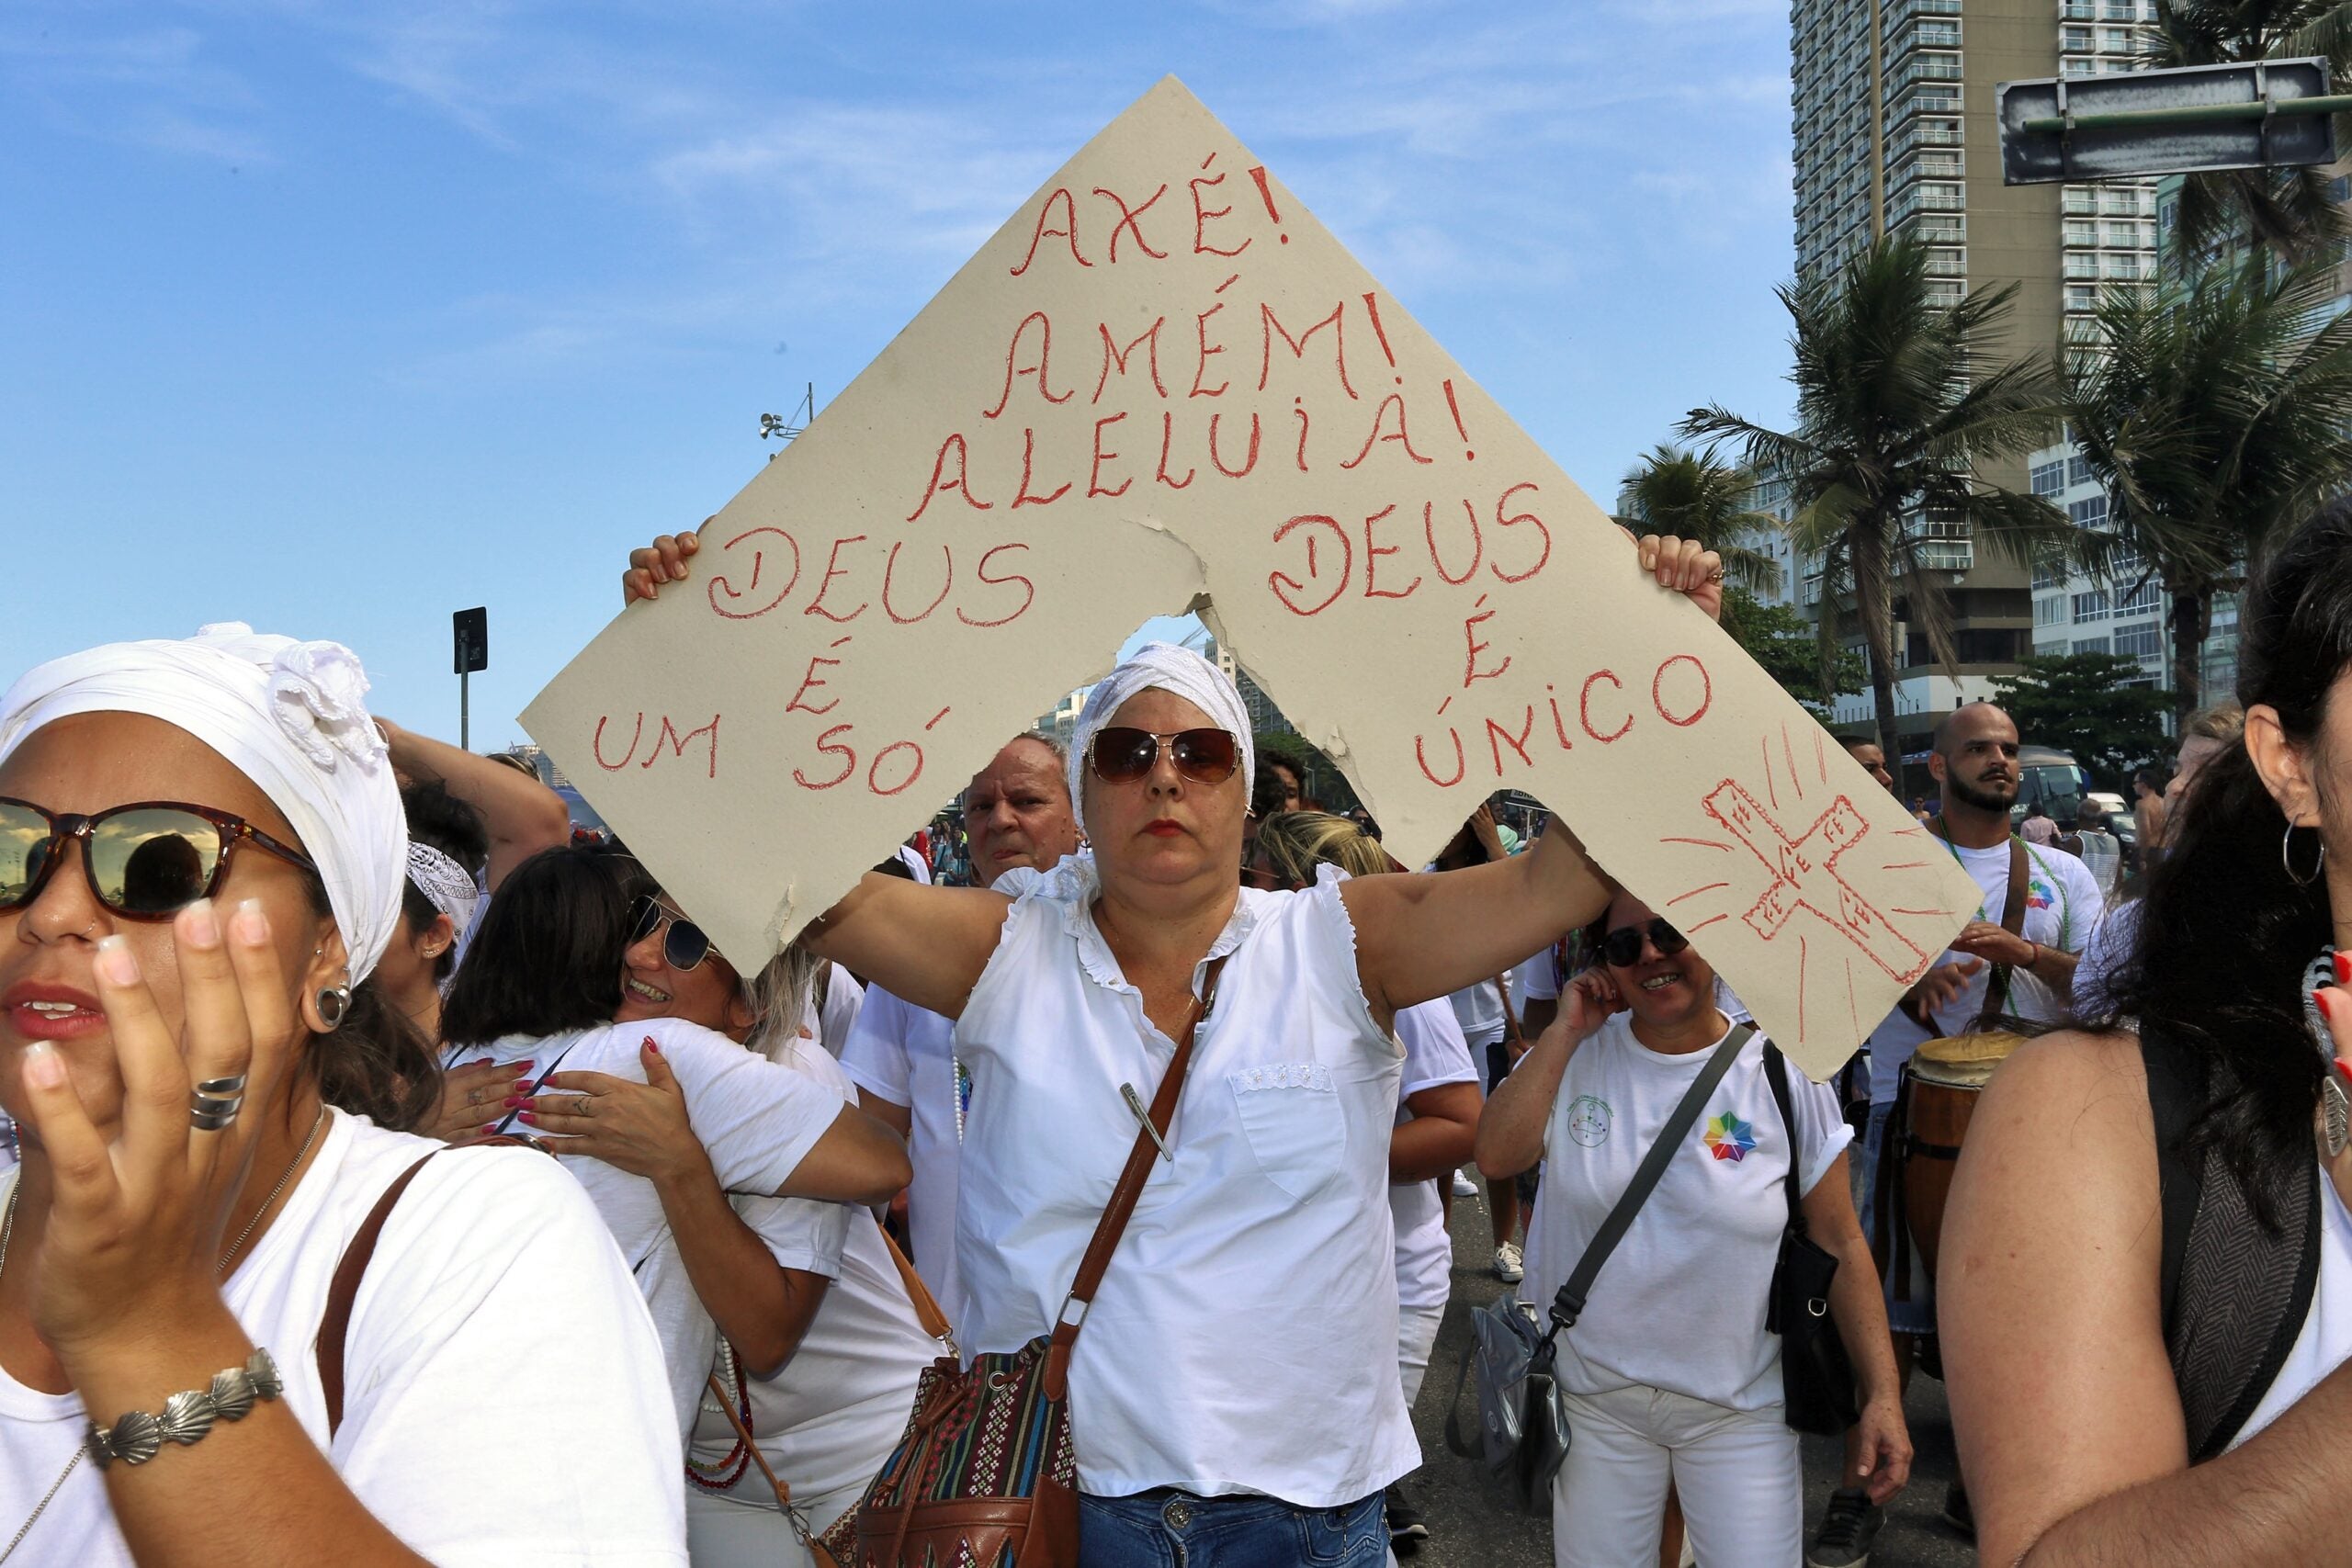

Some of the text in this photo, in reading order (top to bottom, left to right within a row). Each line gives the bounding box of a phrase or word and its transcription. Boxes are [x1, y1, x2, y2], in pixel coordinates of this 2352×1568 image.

[1010, 152, 1290, 277] AXÉ!
[983, 273, 1404, 420] AMÉM!
[707, 526, 1035, 628] DEUS
[1268, 480, 1553, 617] DEUS
[786, 636, 852, 715] É
[1464, 592, 1512, 689] É
[594, 705, 951, 797] UM SÓ
